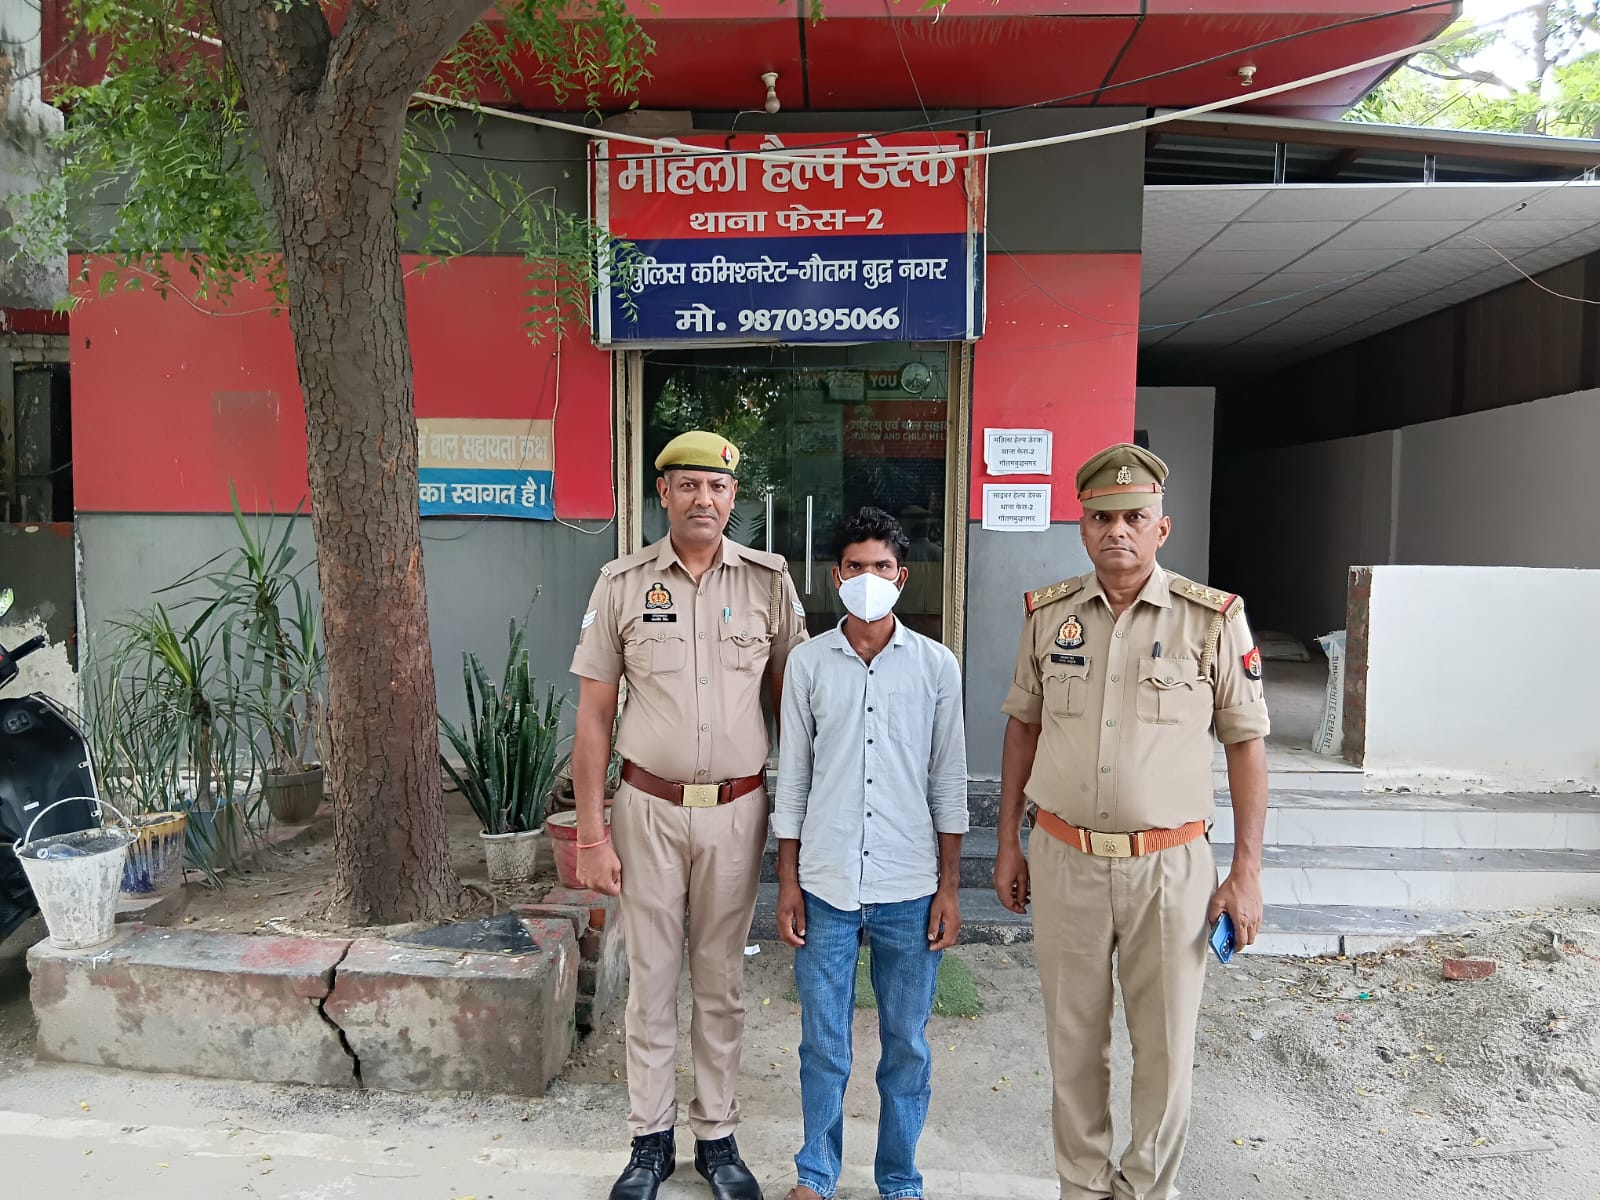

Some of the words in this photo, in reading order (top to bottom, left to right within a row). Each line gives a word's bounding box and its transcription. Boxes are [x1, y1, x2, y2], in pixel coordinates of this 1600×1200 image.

[616, 137, 747, 195] महिला
[856, 133, 960, 189] डेस्क
[689, 209, 767, 233] थाना
[898, 258, 948, 280] नगर
[675, 303, 727, 332] मो.
[738, 306, 900, 332] 9870395066
[870, 374, 897, 388] YOU
[430, 433, 459, 461] बाल
[462, 434, 516, 463] सहायता
[883, 432, 901, 441] AND
[902, 432, 927, 441] CHILD
[419, 483, 447, 503] का
[451, 484, 517, 505] स्वागत
[1324, 714, 1336, 748] CEMENT
